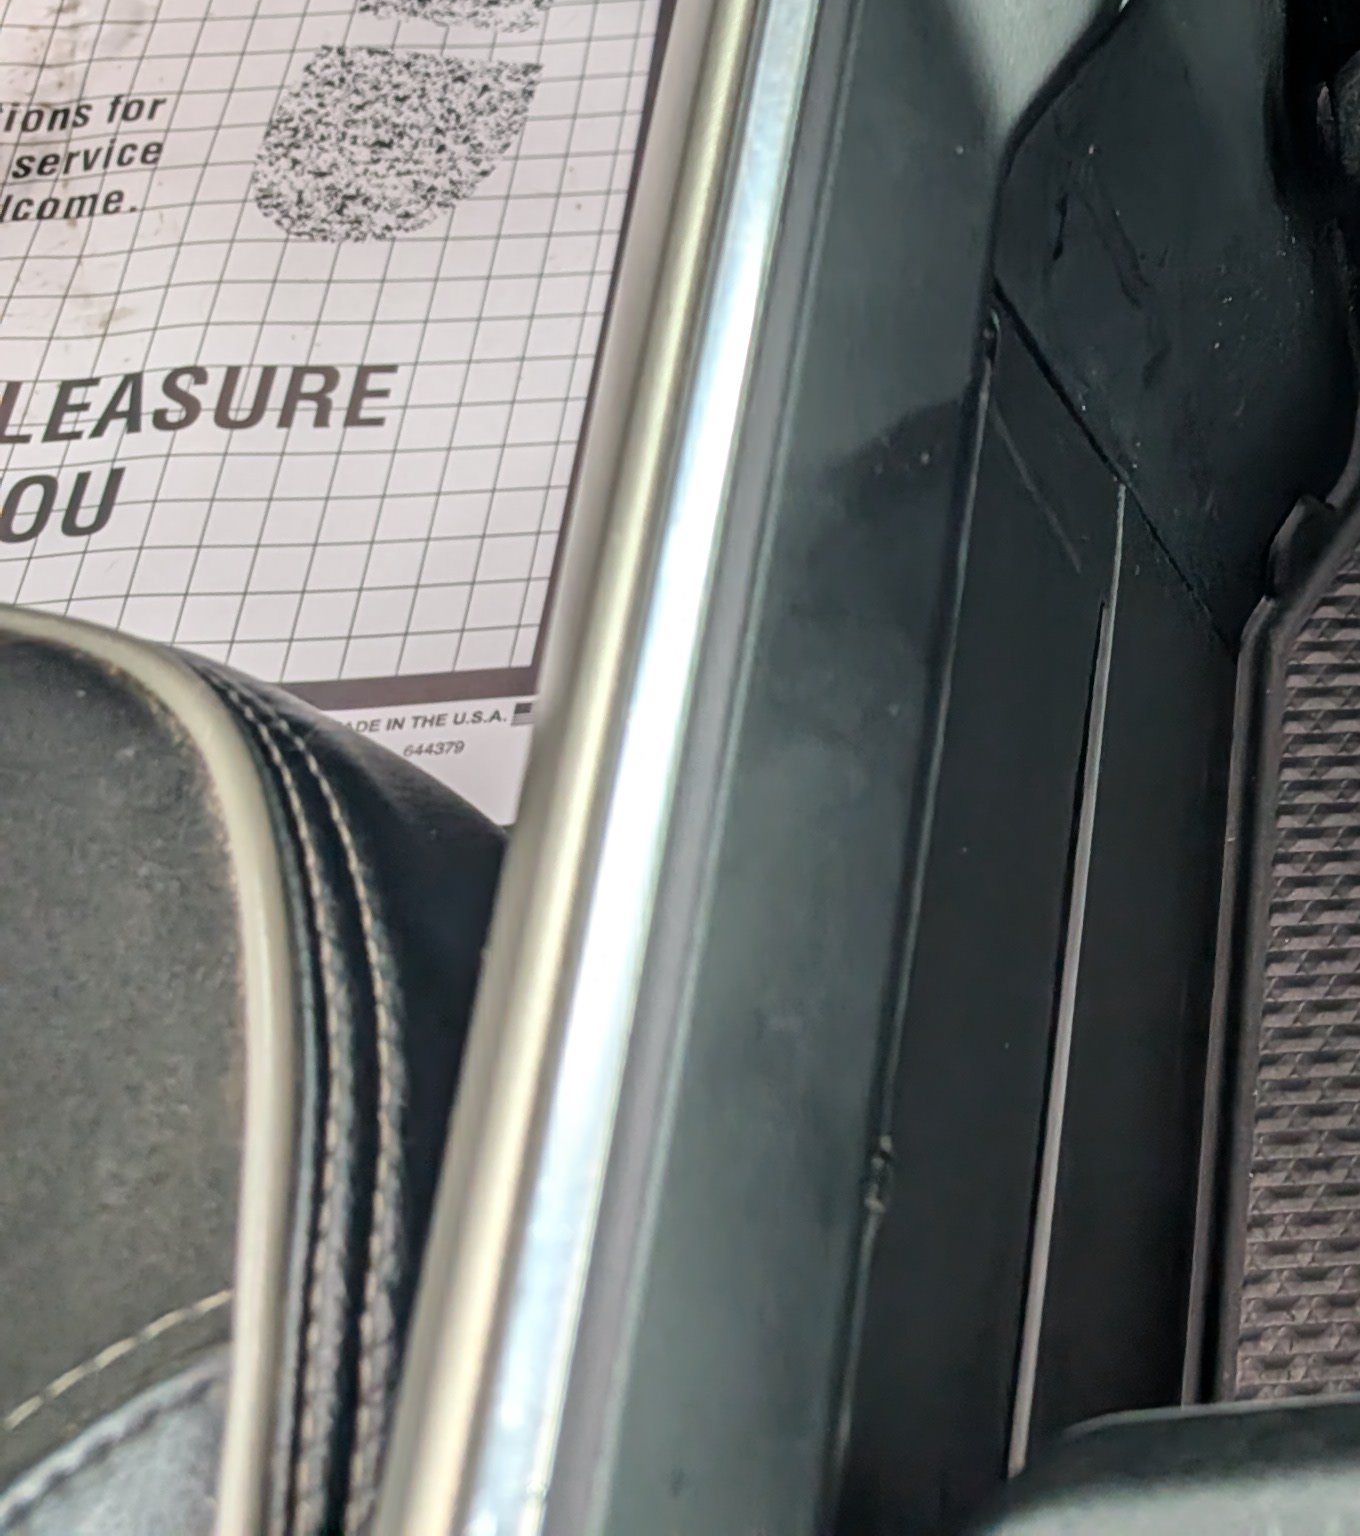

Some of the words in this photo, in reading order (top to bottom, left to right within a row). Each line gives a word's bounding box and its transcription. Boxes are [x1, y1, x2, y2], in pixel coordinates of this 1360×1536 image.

[0, 102, 93, 133] ions
[107, 94, 167, 124] for
[11, 138, 163, 179] service
[386, 716, 406, 731] IN
[412, 714, 447, 730] THE
[453, 709, 507, 726] U.S.A.
[403, 741, 465, 757] 644379
